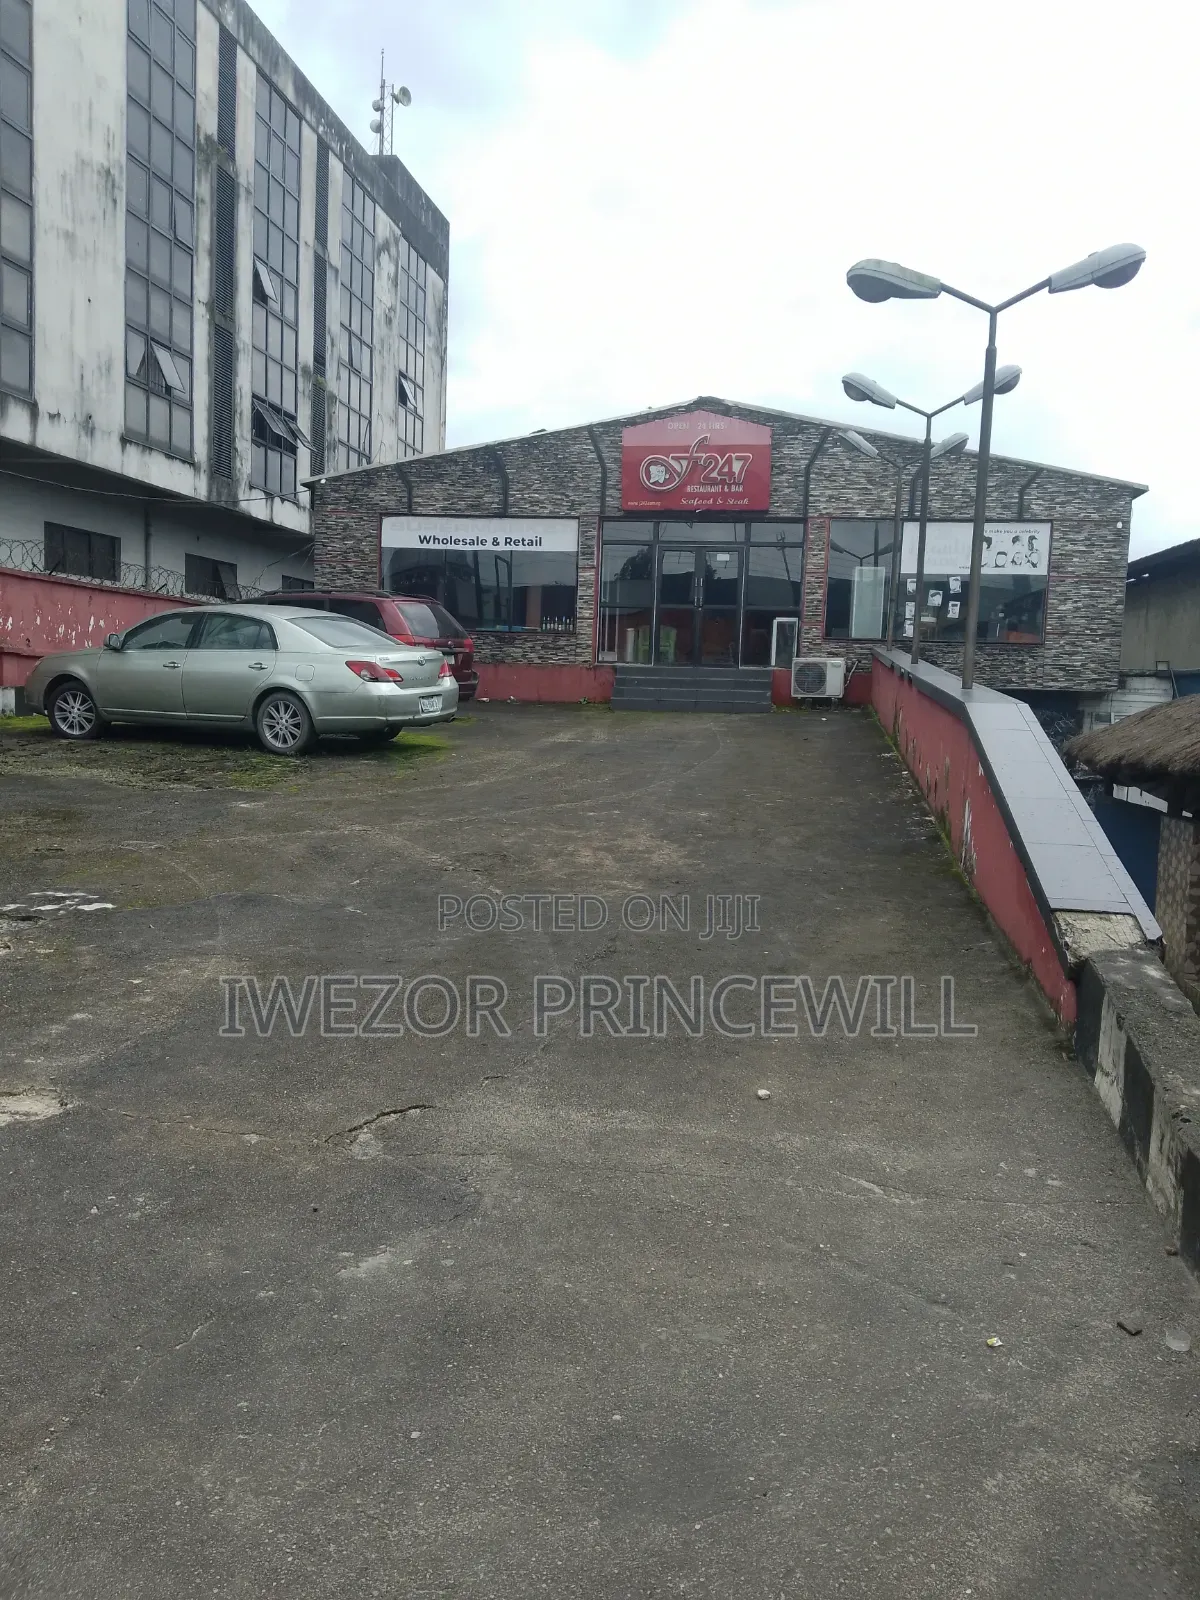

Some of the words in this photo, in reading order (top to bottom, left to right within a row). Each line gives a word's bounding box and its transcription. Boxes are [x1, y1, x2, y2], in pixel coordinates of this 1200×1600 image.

[667, 421, 689, 430] OPEN
[687, 485, 722, 493] RESTAURANT
[731, 485, 744, 493] BAR
[680, 497, 713, 506] Seafood
[716, 496, 723, 505] &
[726, 497, 749, 505] Steak
[418, 535, 488, 546] Wholesale
[491, 536, 500, 546] &
[504, 535, 542, 547] Retail
